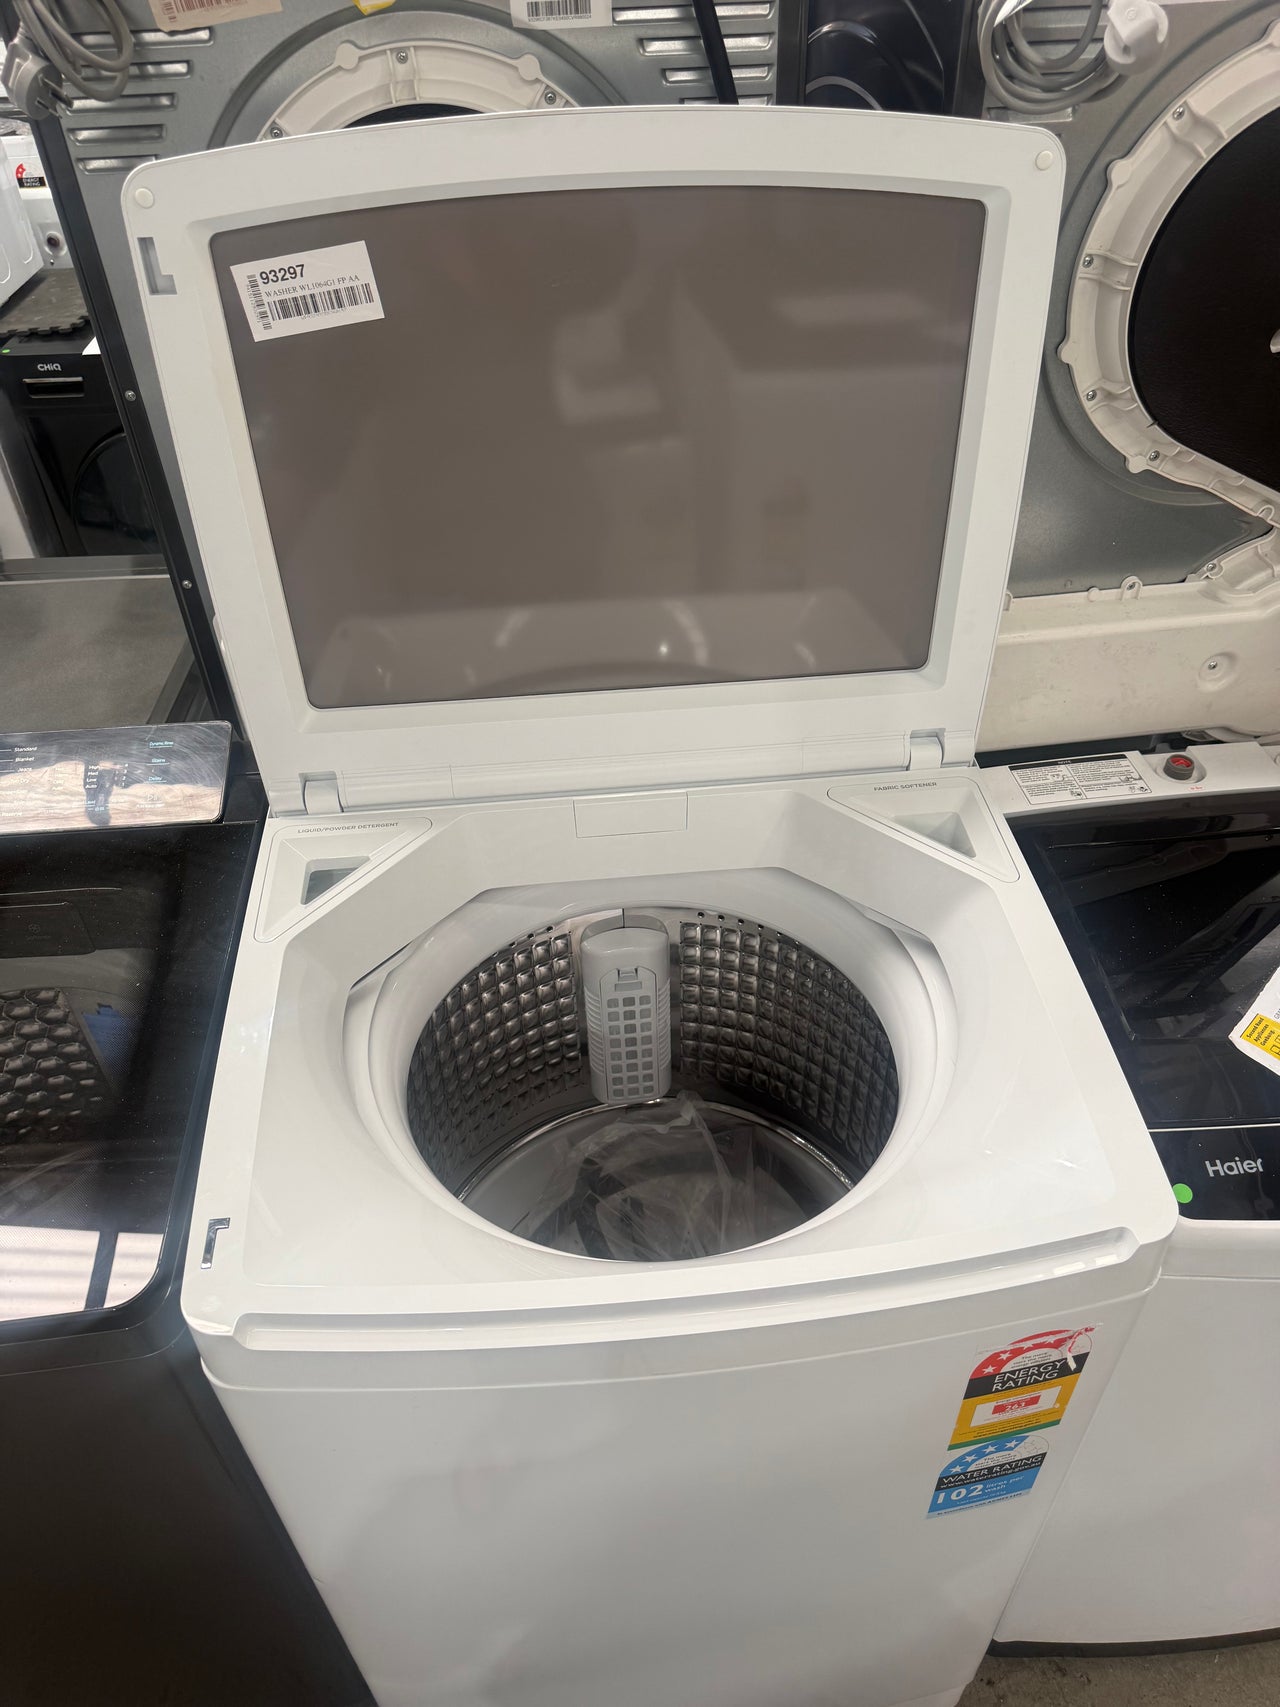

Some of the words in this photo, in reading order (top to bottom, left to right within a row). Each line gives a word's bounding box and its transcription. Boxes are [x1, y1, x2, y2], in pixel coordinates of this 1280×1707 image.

[259, 264, 305, 285] 93297
[264, 287, 298, 298] WASHER
[337, 277, 346, 285] FP
[1205, 1156, 1264, 1177] Haier
[992, 1370, 1059, 1392] RATING
[994, 1359, 1068, 1383] ENERGY
[943, 1469, 989, 1483] WATER
[993, 1455, 1043, 1471] RATING
[937, 1484, 984, 1504] 102
